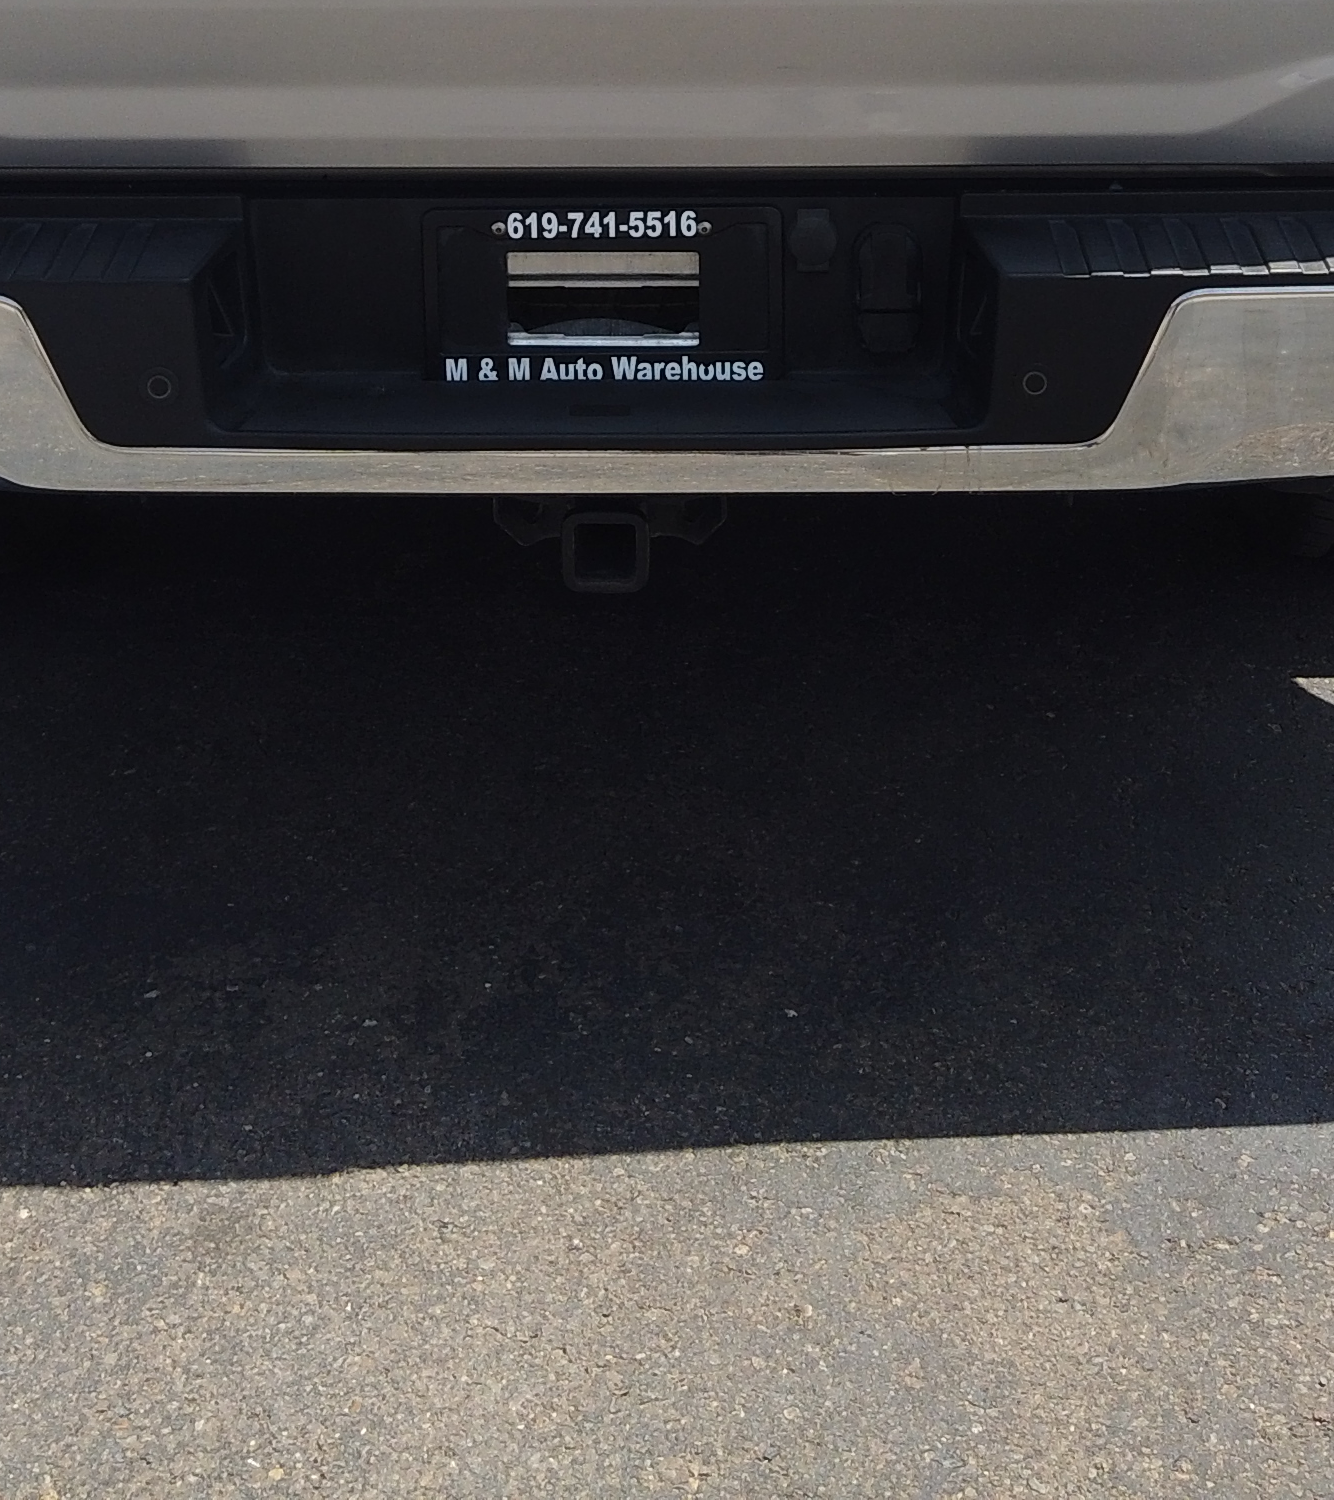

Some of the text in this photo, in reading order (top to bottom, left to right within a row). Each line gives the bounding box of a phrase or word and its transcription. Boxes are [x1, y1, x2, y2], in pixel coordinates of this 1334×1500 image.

[506, 211, 698, 239] 619-741-5516
[445, 355, 764, 381] M & M Auto Warehouse
